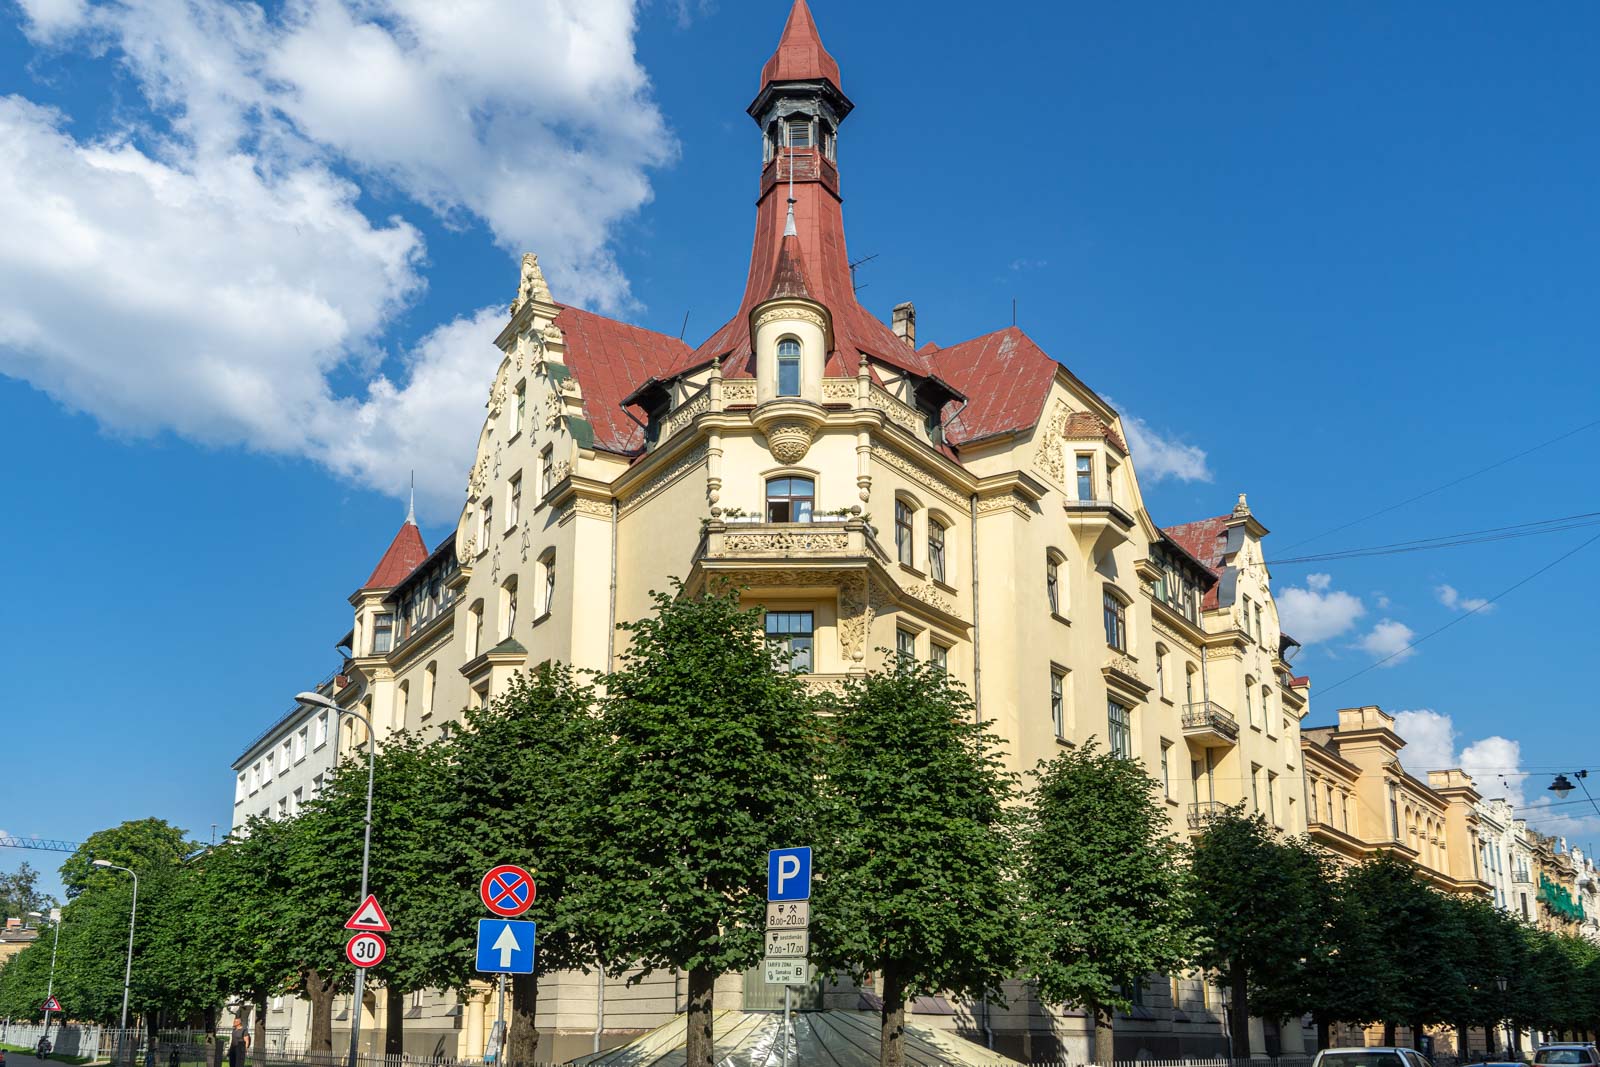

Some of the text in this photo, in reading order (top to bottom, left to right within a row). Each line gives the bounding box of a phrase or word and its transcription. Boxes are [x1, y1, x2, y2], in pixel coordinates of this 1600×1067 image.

[778, 855, 800, 894] P
[357, 941, 376, 958] 30
[795, 967, 802, 976] B
